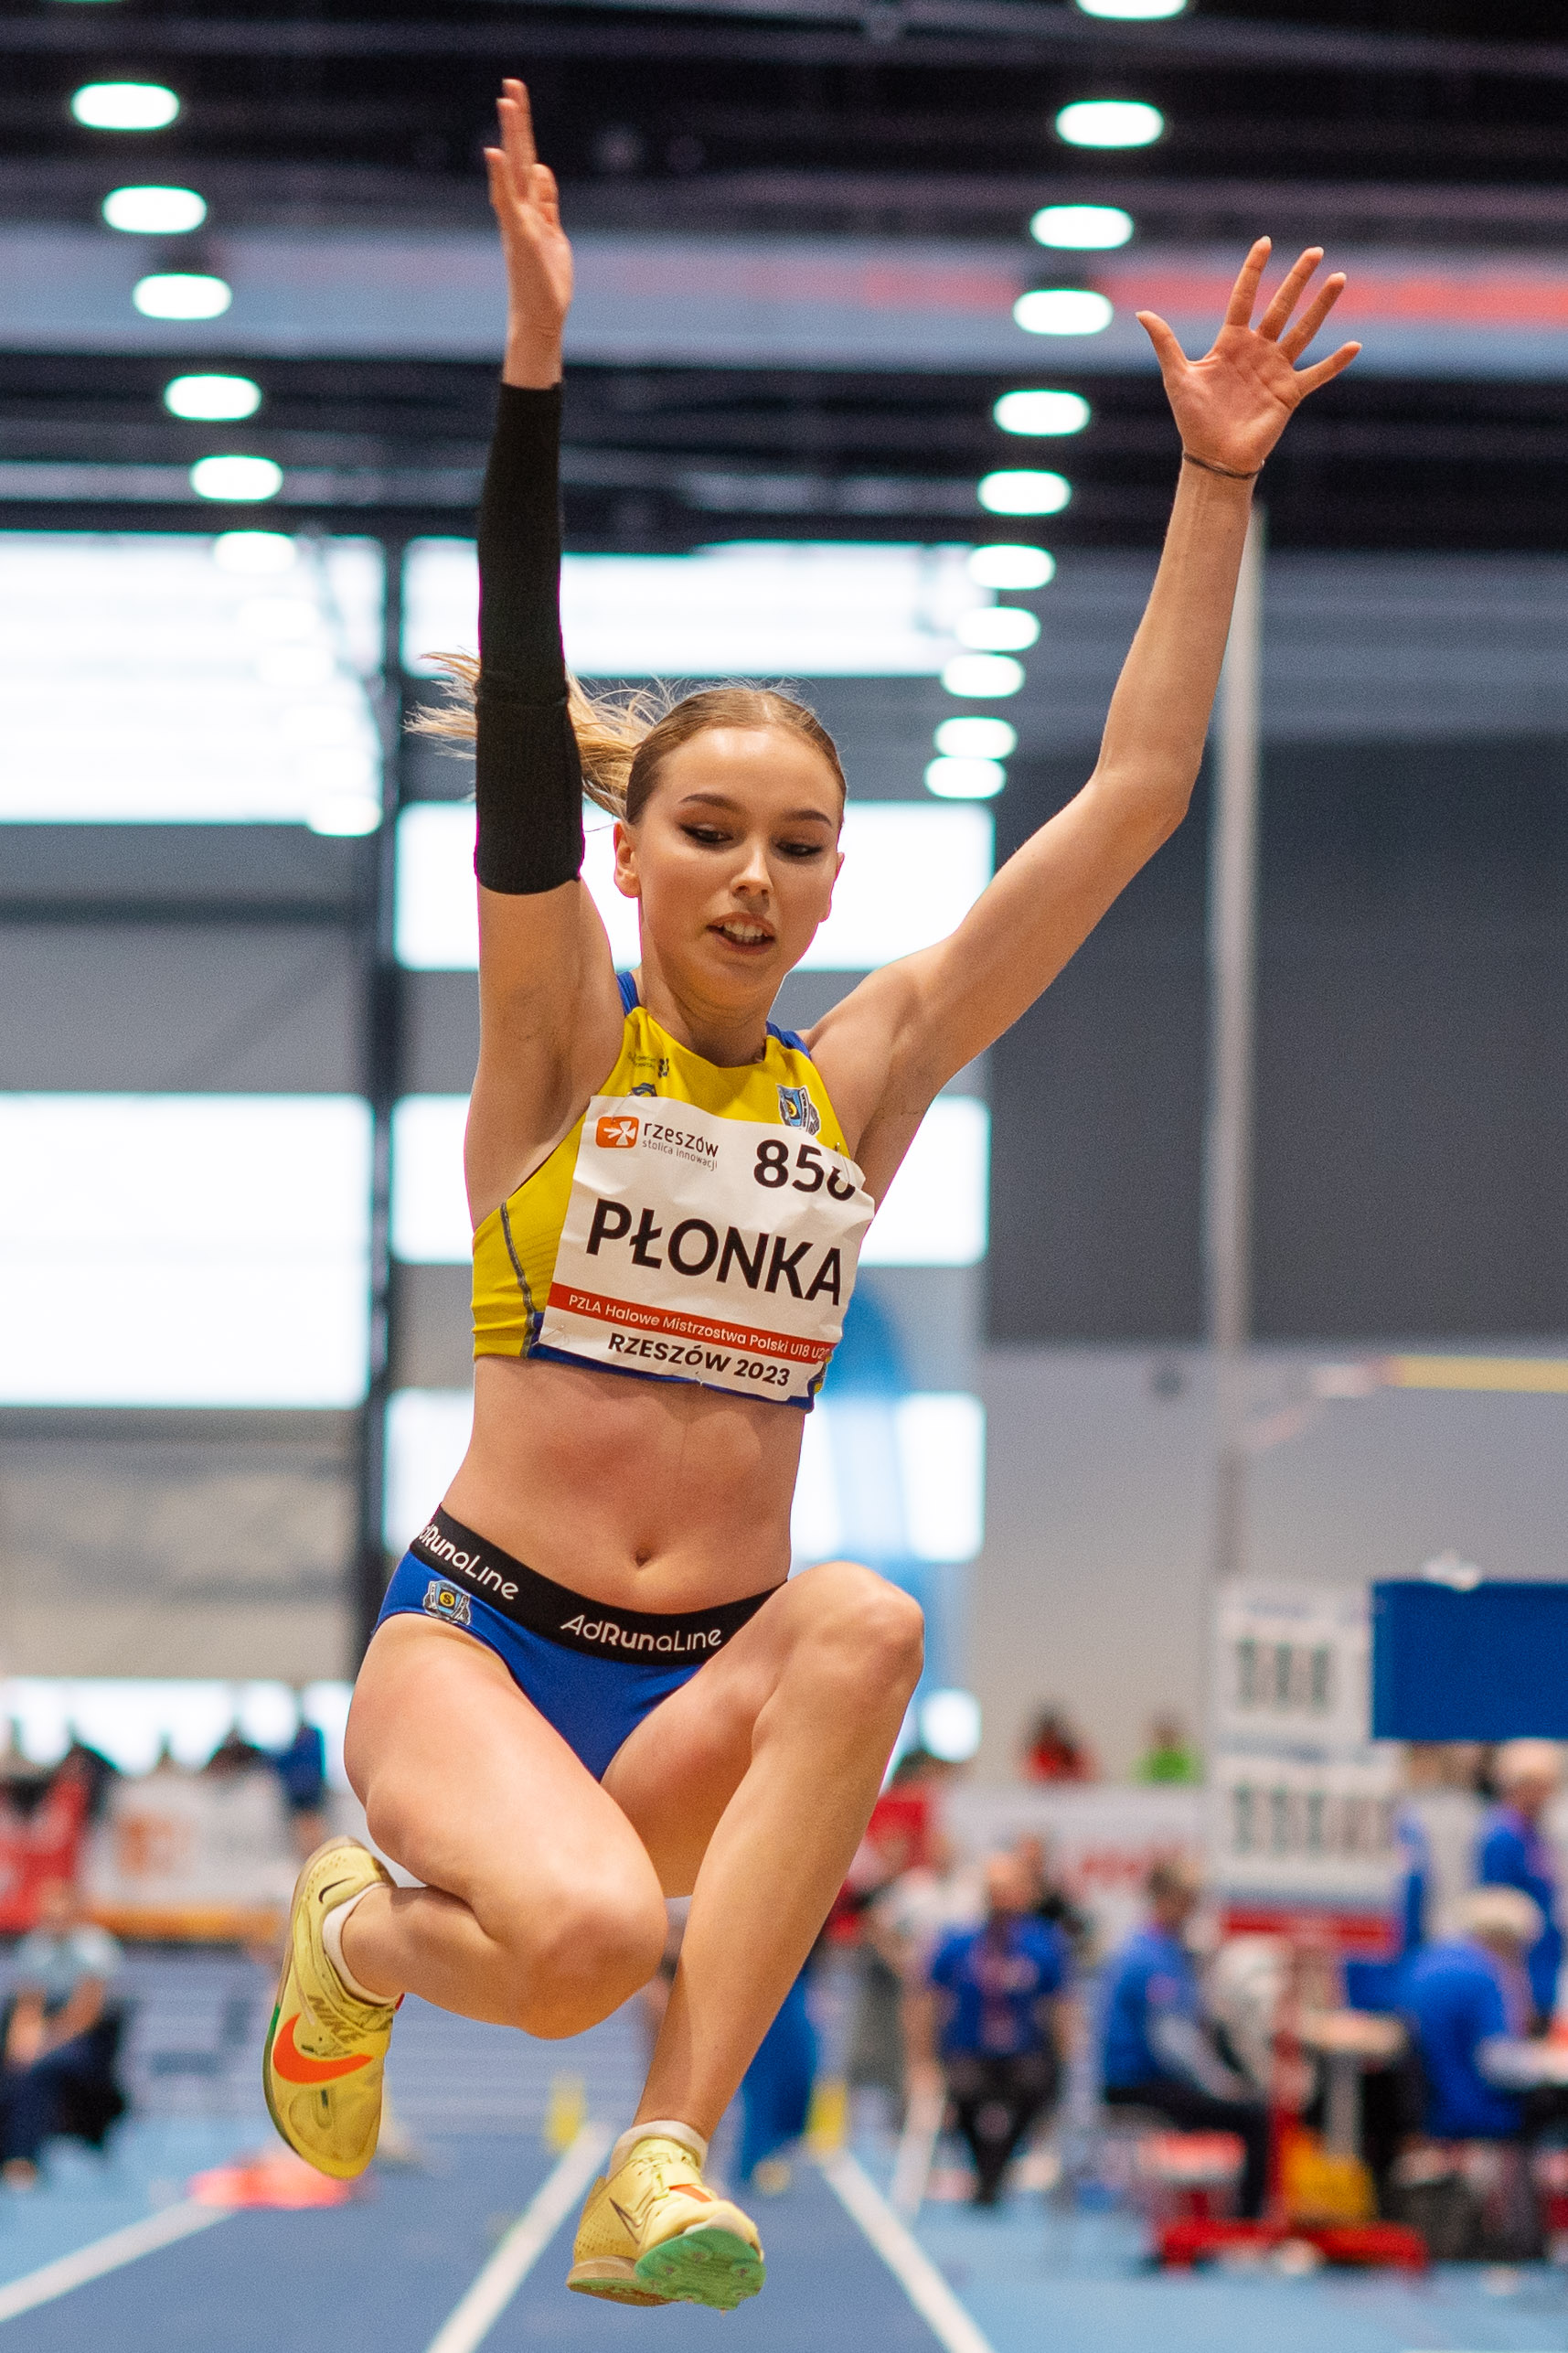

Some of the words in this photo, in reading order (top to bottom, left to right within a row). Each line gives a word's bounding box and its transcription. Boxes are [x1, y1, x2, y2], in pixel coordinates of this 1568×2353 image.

[642, 1139, 674, 1155] stolica
[676, 1148, 718, 1171] innowacji
[643, 1122, 719, 1158] rzeszów
[585, 1198, 841, 1306] PŁONKA
[569, 1294, 602, 1314] PZLA
[604, 1303, 660, 1326] Halowe
[662, 1317, 747, 1344] Mistrzostwa
[750, 1334, 789, 1353] Polski
[790, 1342, 810, 1358] U18
[607, 1332, 731, 1373] RZESZÓW
[733, 1358, 791, 1386] 2023
[418, 1524, 519, 1600] dRunaLine
[560, 1614, 722, 1652] AdRunaLine
